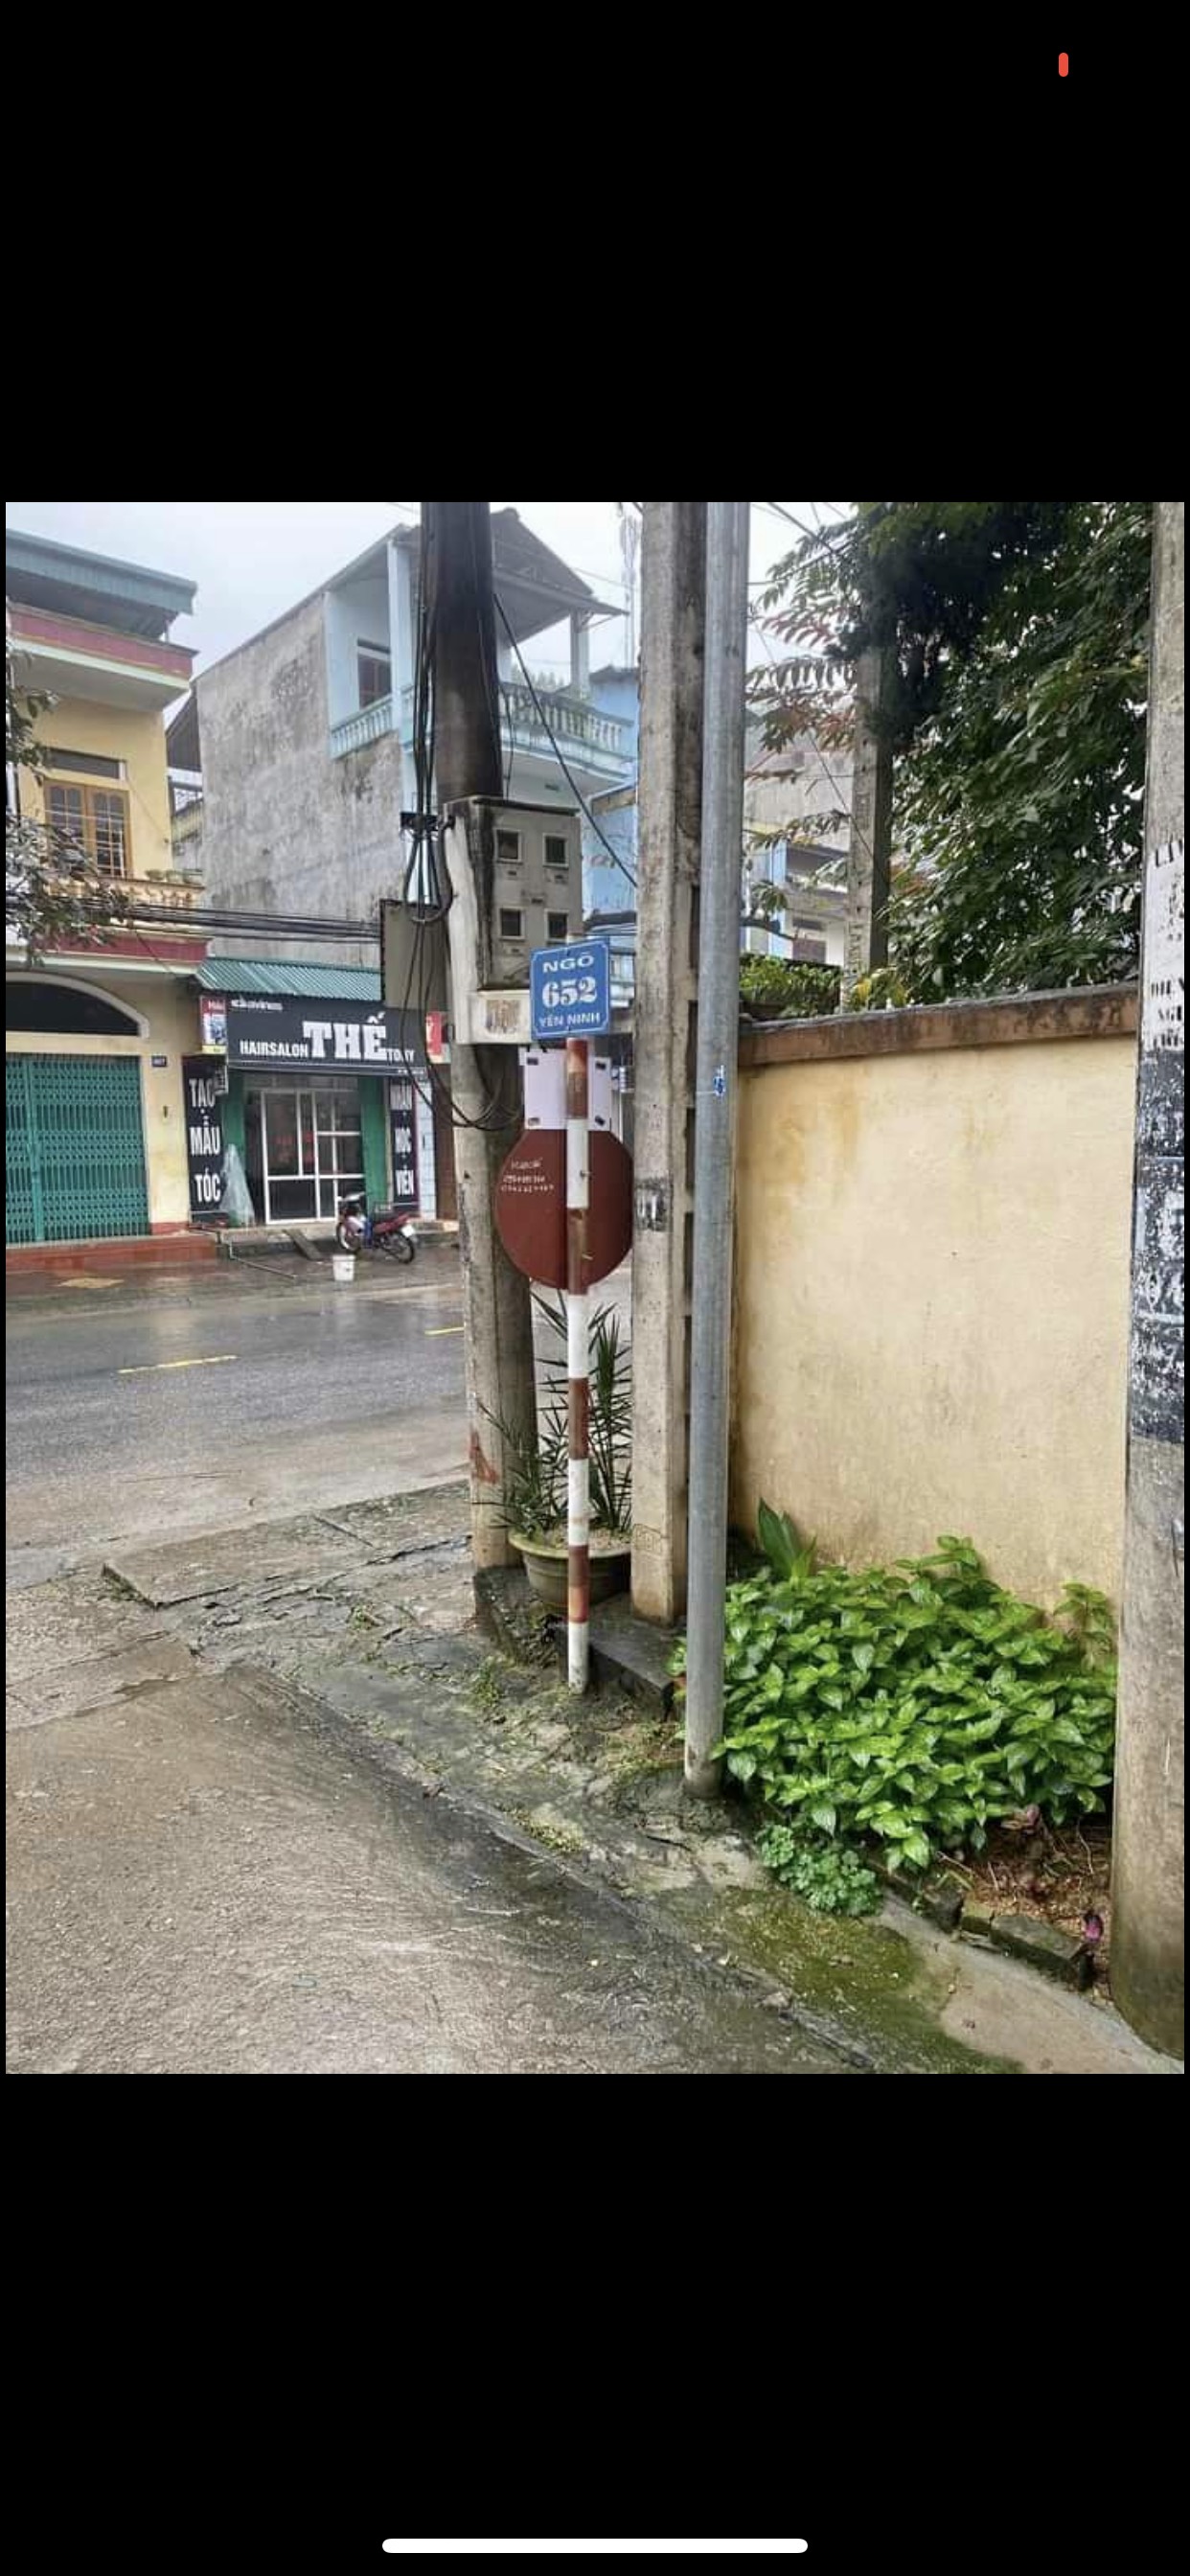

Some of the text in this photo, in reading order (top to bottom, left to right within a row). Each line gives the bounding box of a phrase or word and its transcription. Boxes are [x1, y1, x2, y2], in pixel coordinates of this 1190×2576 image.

[542, 977, 597, 1007] 652
[567, 1012, 600, 1024] NINH
[240, 1040, 308, 1057] HAIRSALON
[302, 1012, 387, 1061] THẾ
[195, 1167, 221, 1203] TÓC
